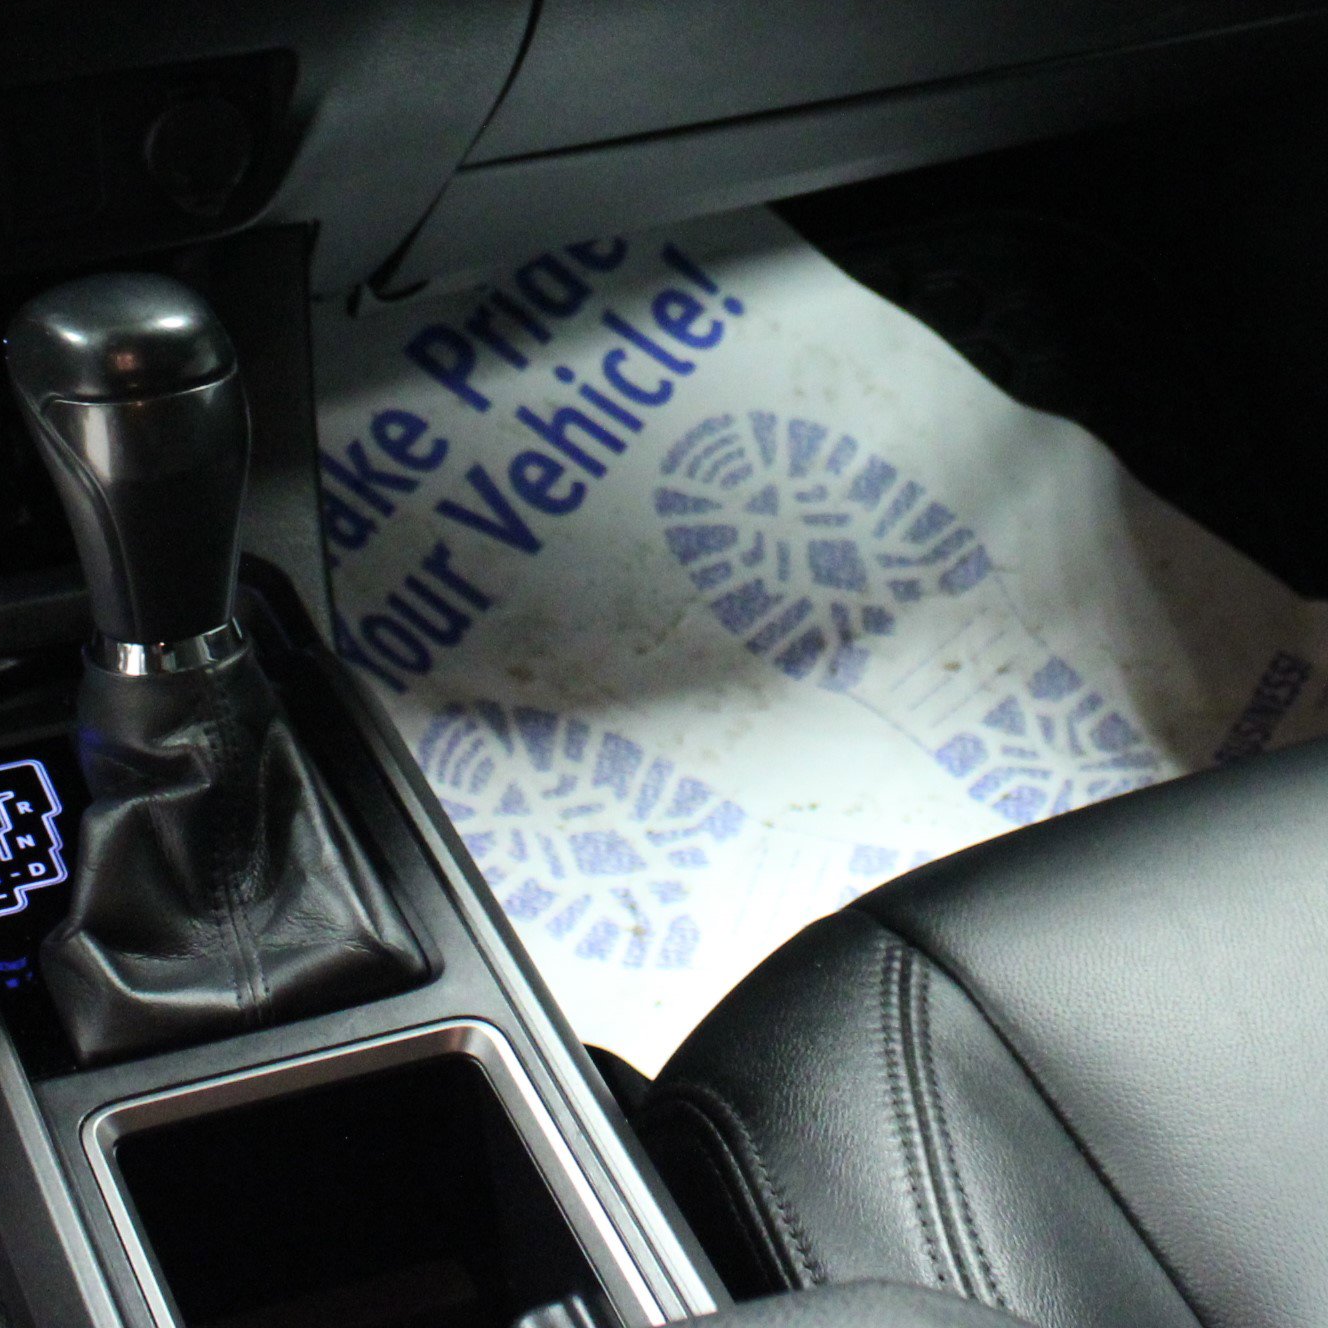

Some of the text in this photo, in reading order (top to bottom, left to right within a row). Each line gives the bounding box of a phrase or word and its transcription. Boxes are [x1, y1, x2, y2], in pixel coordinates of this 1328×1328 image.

[436, 241, 746, 556] Vehicle!
[317, 407, 450, 568] ake
[15, 800, 35, 815] R
[15, 833, 37, 850] N
[27, 861, 47, 877] D
